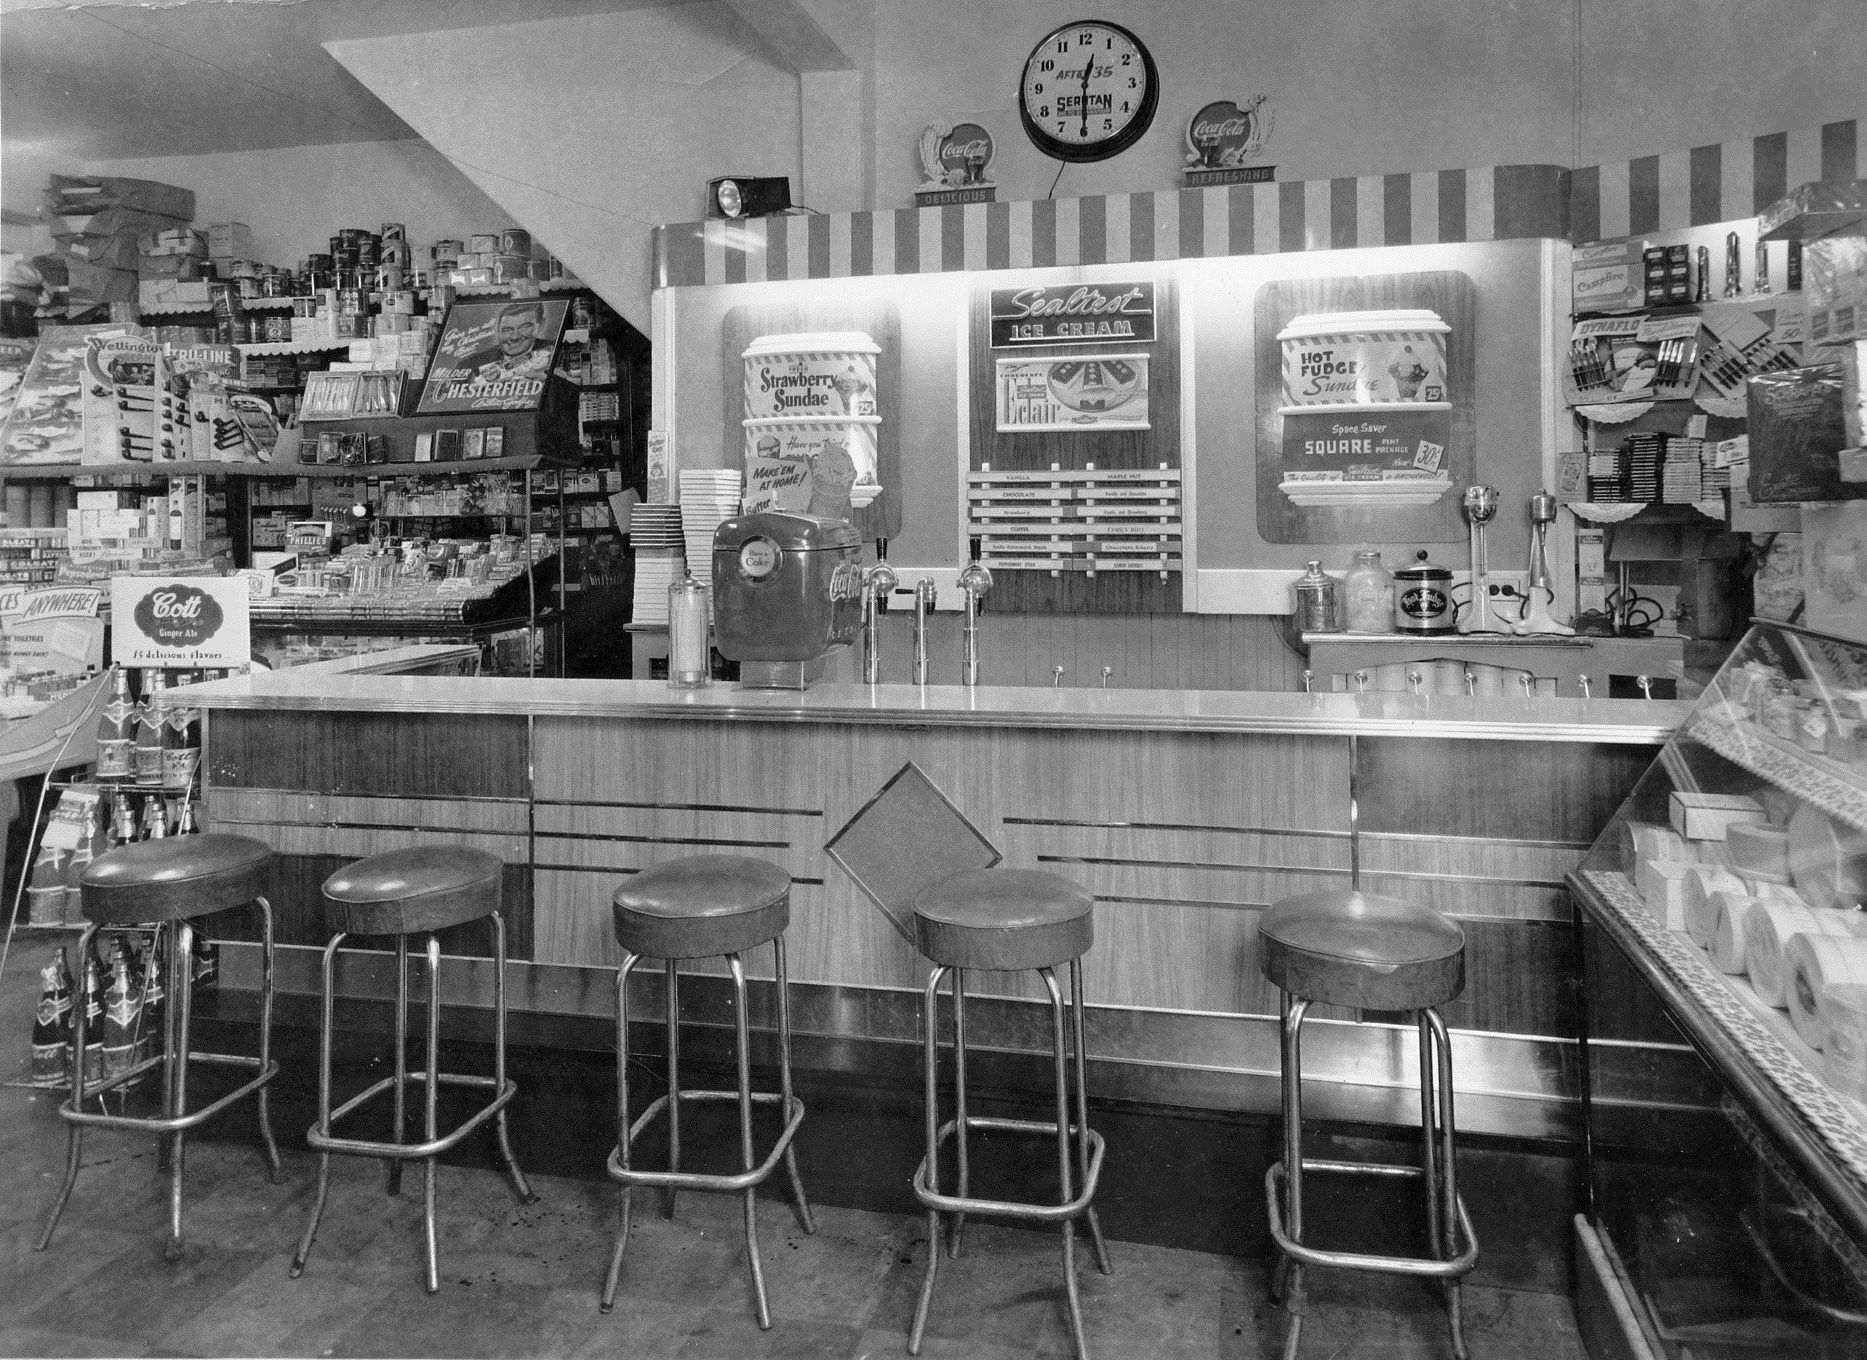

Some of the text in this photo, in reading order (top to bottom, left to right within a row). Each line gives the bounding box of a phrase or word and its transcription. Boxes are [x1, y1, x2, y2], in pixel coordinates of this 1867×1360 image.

[1080, 33, 1093, 46] 12
[1106, 38, 1112, 50] 1
[1057, 41, 1068, 53] 11
[1041, 59, 1055, 72] 10
[1122, 53, 1131, 66] 2
[1056, 66, 1114, 81] AFTE 35
[1034, 83, 1044, 95] 9
[1128, 77, 1137, 89] 3
[1056, 94, 1112, 112] SERTAN
[1120, 101, 1130, 113] 4
[1040, 105, 1050, 118] 8
[1057, 121, 1066, 133] 7
[1103, 118, 1112, 131] 5
[1192, 169, 1269, 185] REFRESHING
[925, 190, 986, 205] DELICIOUS
[1577, 272, 1624, 293] Campfire
[992, 287, 1153, 321] Sealtest
[1011, 320, 1133, 339] ICE CREAM
[1301, 350, 1334, 365] HOT
[431, 367, 472, 379] MILDER
[1301, 361, 1358, 377] FUDGE
[760, 367, 838, 393] Strawberry
[1302, 375, 1380, 396] Sunde
[432, 379, 544, 404] CHESTERFIELD
[1426, 388, 1441, 401] 25
[773, 387, 829, 413] Sundae
[1331, 422, 1388, 436] Space Saver
[1305, 439, 1373, 456] SQUARE
[753, 467, 779, 480] MAKE
[289, 536, 328, 545] PHILLIES
[745, 557, 769, 567] Coke
[22, 592, 100, 618] ANYWHERE!
[152, 591, 202, 618] Cott
[159, 628, 199, 639] Ginger Ale
[145, 649, 187, 659] delicious
[190, 649, 222, 659] flavors
